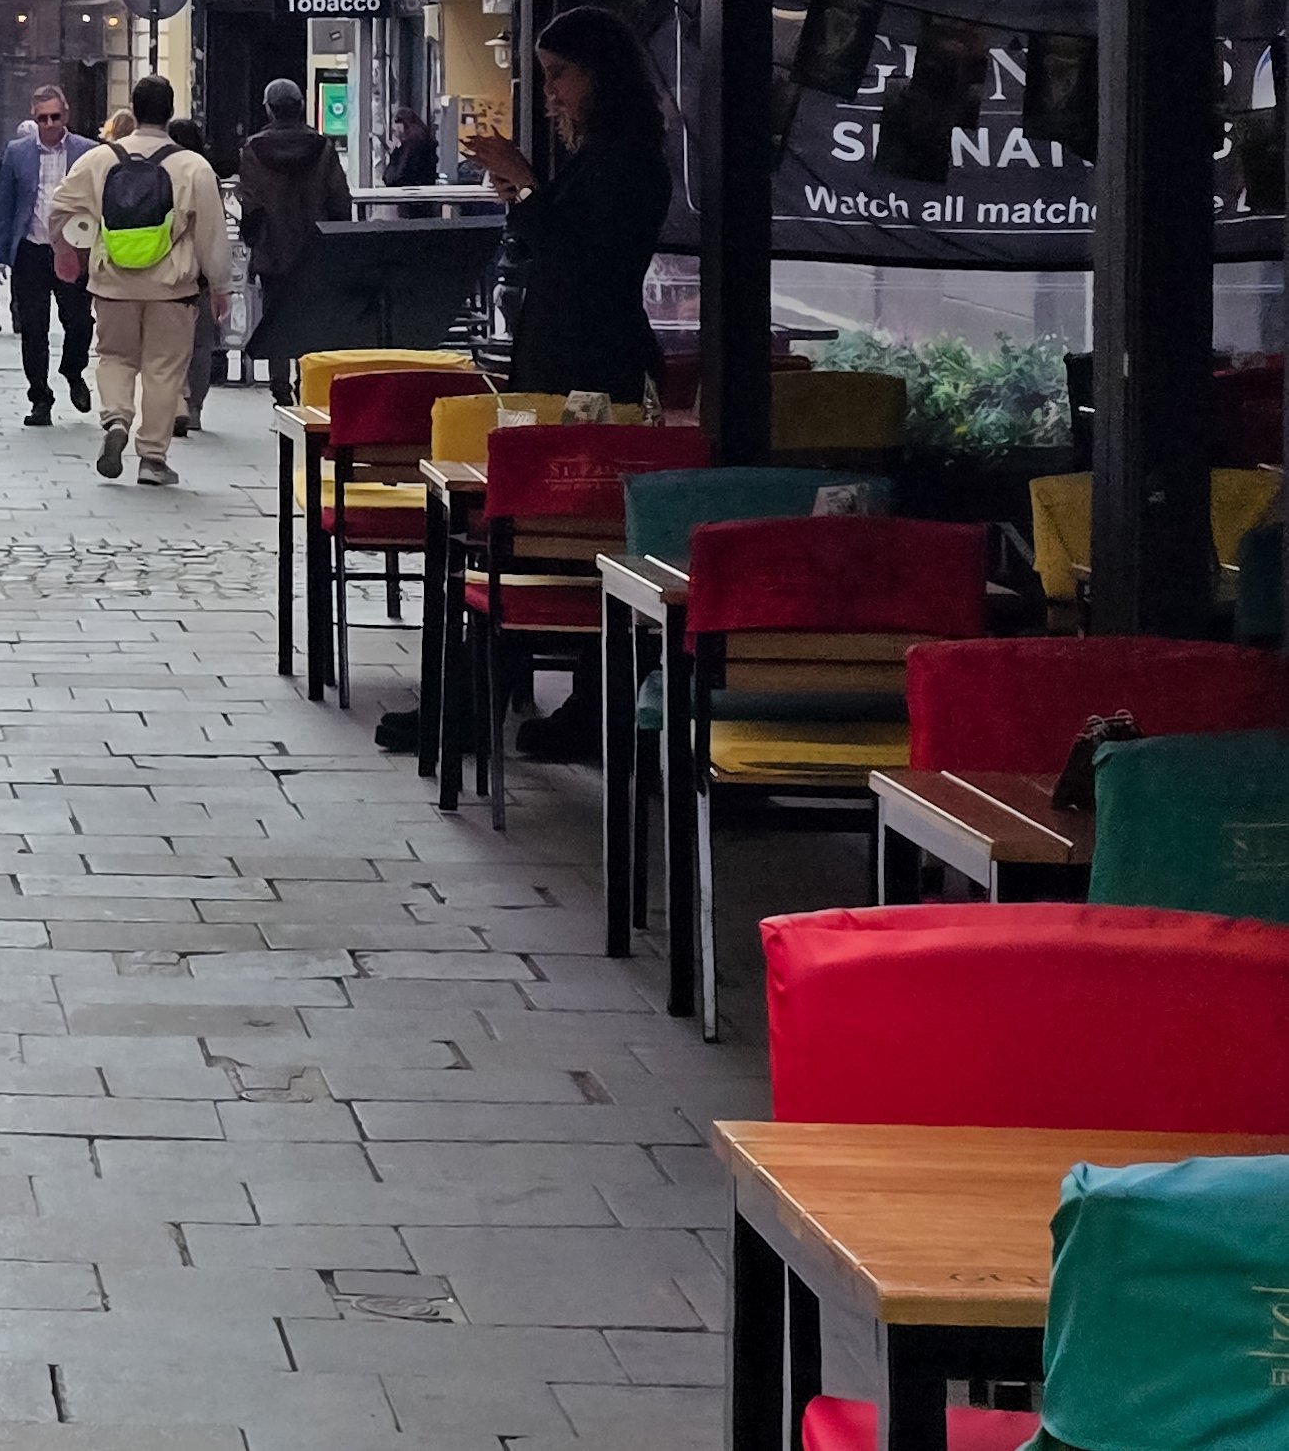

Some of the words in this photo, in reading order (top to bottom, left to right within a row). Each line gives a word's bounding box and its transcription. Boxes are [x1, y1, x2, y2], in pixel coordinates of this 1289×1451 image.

[804, 184, 910, 219] Watch
[921, 195, 964, 223] all
[977, 195, 1097, 224] match
